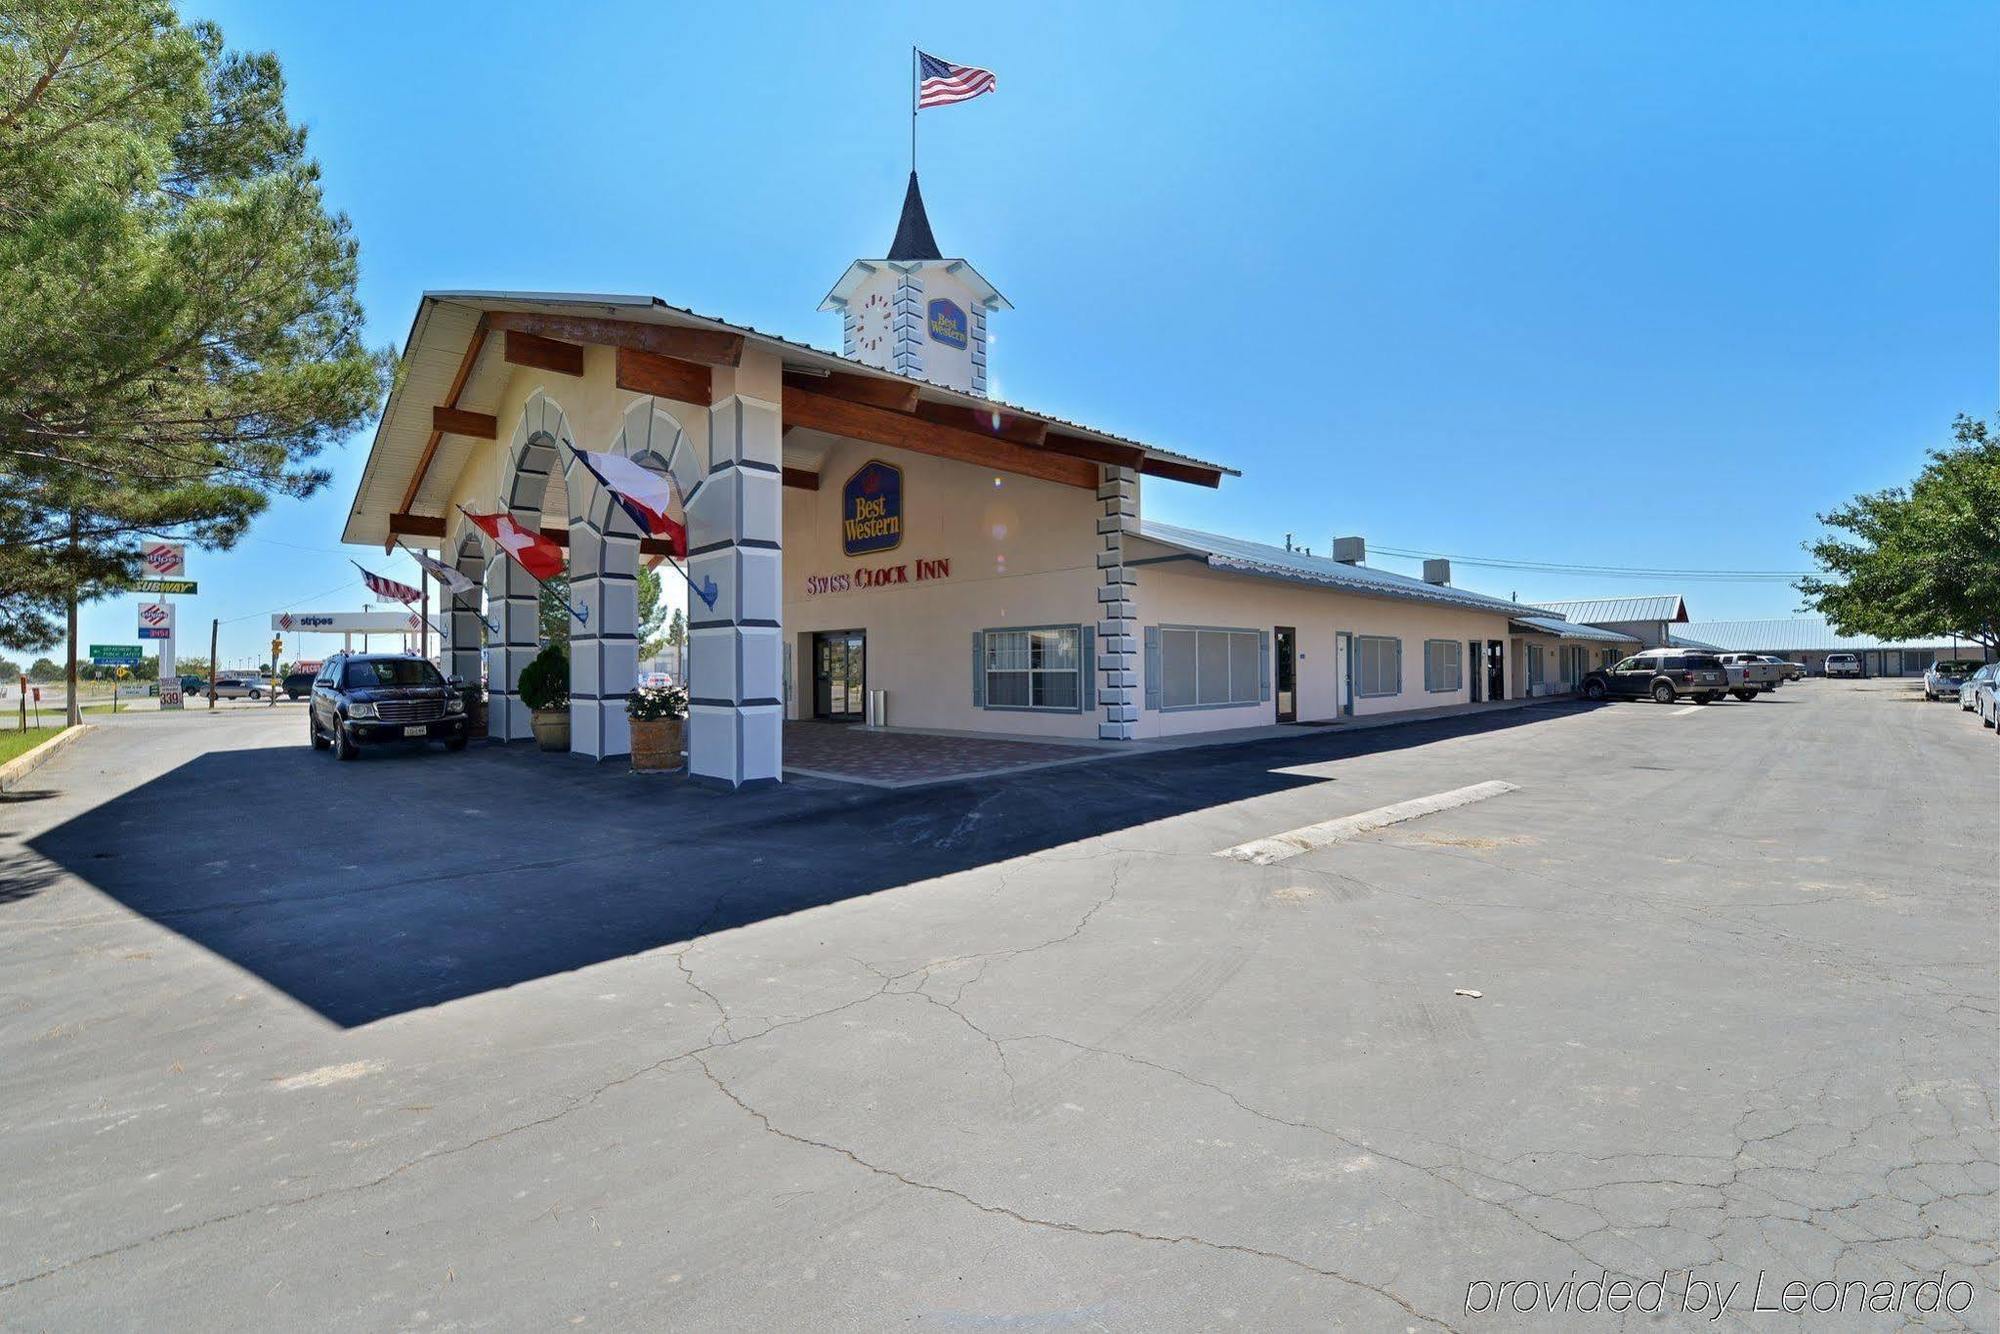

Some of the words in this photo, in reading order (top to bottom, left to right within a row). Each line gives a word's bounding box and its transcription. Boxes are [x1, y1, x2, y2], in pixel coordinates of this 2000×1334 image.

[938, 313, 957, 328] Best
[931, 320, 966, 341] Western
[855, 494, 886, 521] Best
[845, 516, 900, 541] Western
[132, 580, 189, 593] SUBWAY
[300, 616, 333, 627] stripes
